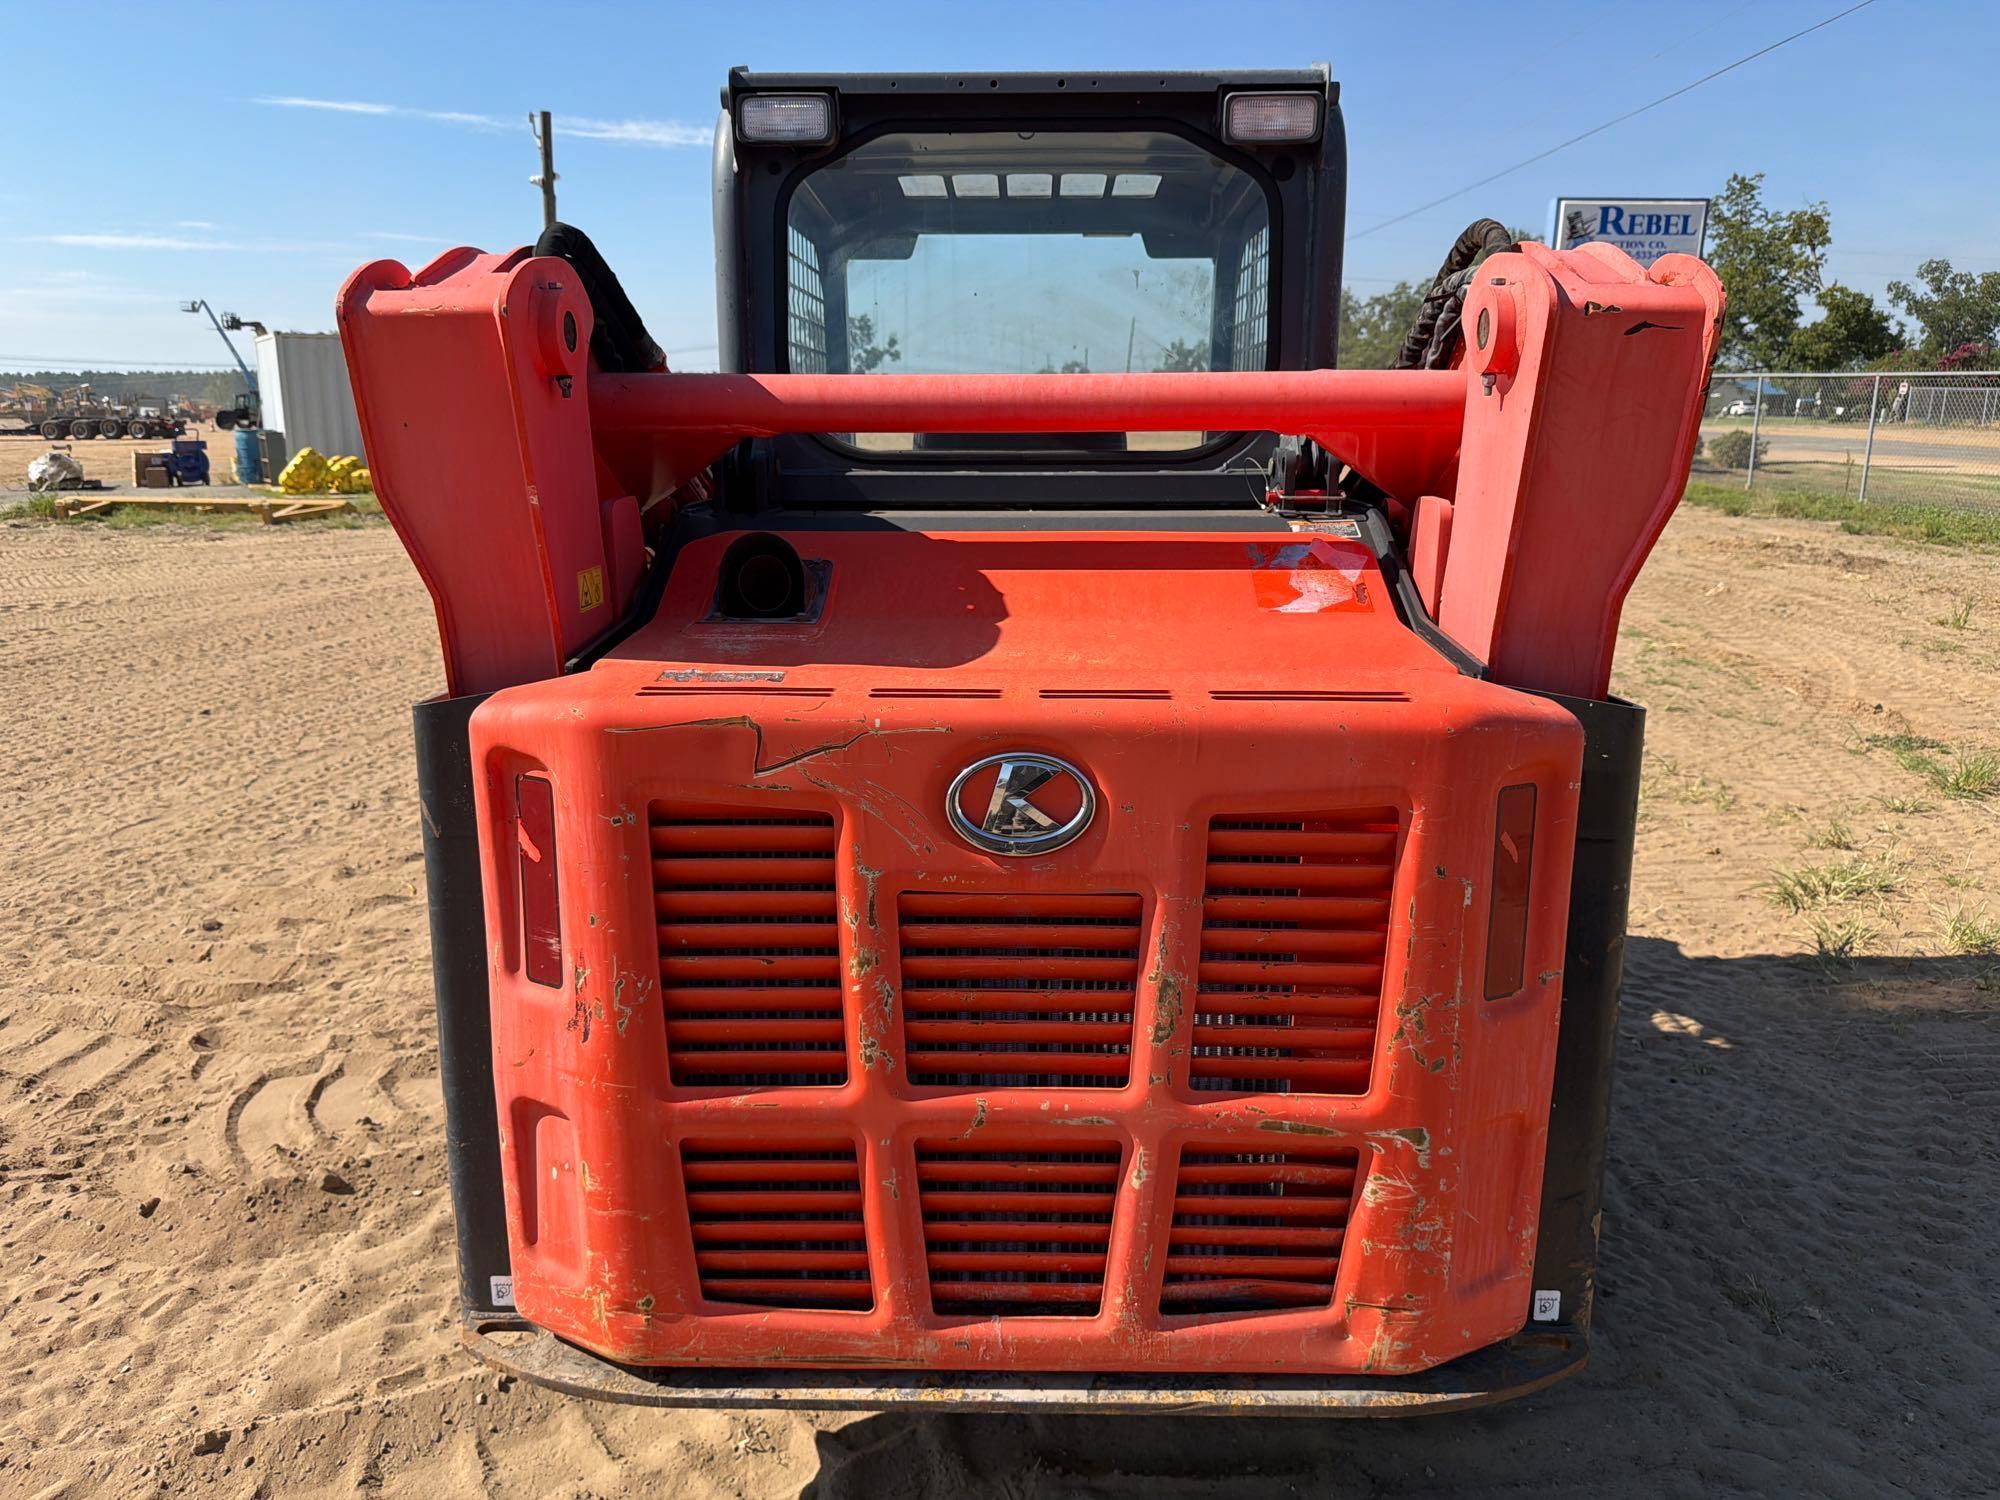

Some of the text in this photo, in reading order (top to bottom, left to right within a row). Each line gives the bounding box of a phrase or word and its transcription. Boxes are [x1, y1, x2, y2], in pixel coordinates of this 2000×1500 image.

[1597, 206, 1697, 236] REBEL
[1648, 240, 1667, 250] CO.
[981, 762, 1062, 836] K
